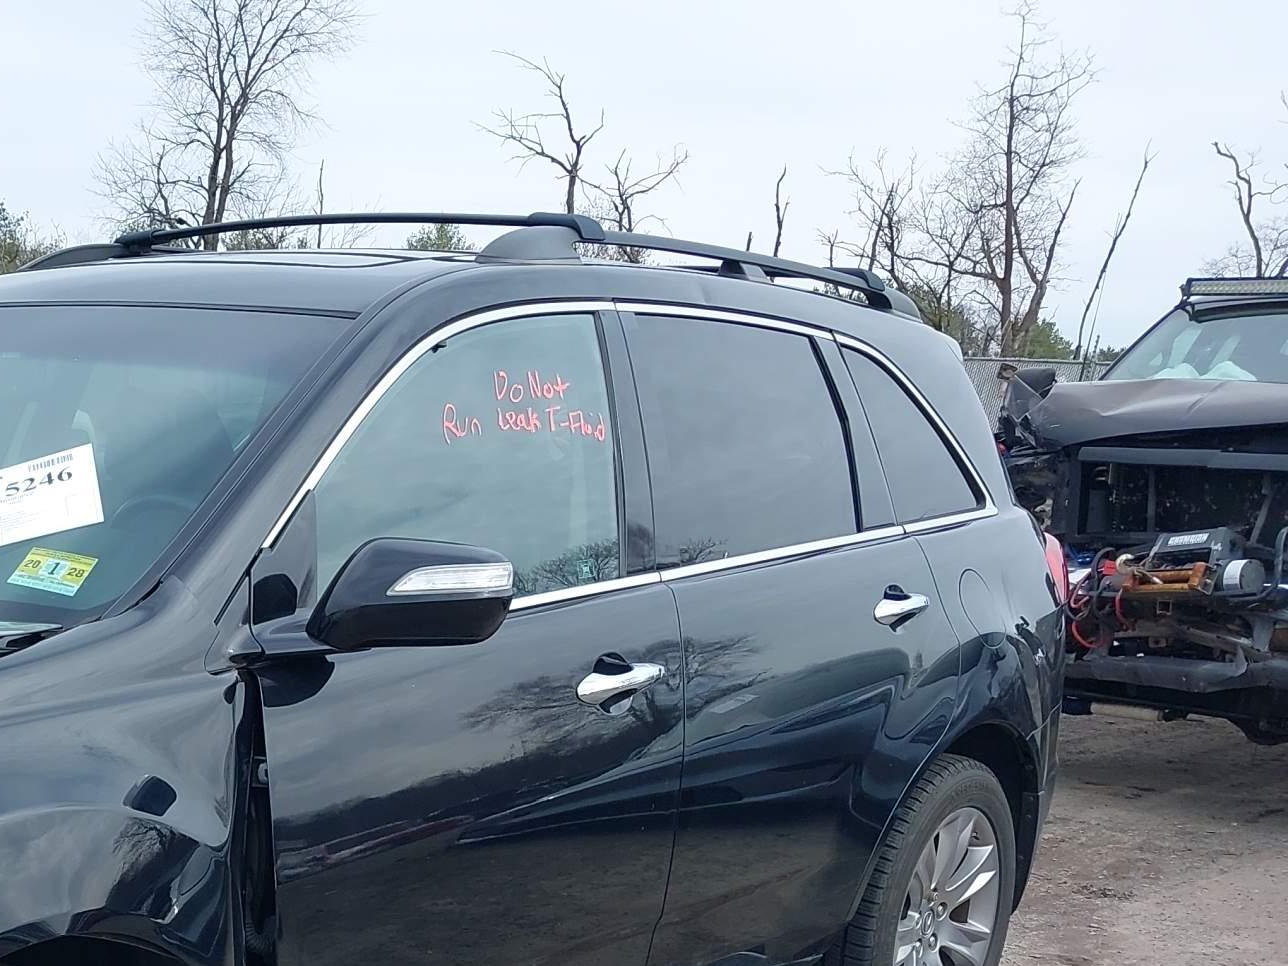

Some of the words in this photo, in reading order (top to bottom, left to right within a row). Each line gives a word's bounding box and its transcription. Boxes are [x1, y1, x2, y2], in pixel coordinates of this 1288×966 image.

[493, 370, 524, 402] Do
[527, 370, 570, 400] Not
[443, 404, 483, 445] Run
[24, 559, 42, 569] 20
[47, 562, 61, 575] 1
[66, 567, 86, 578] 28
